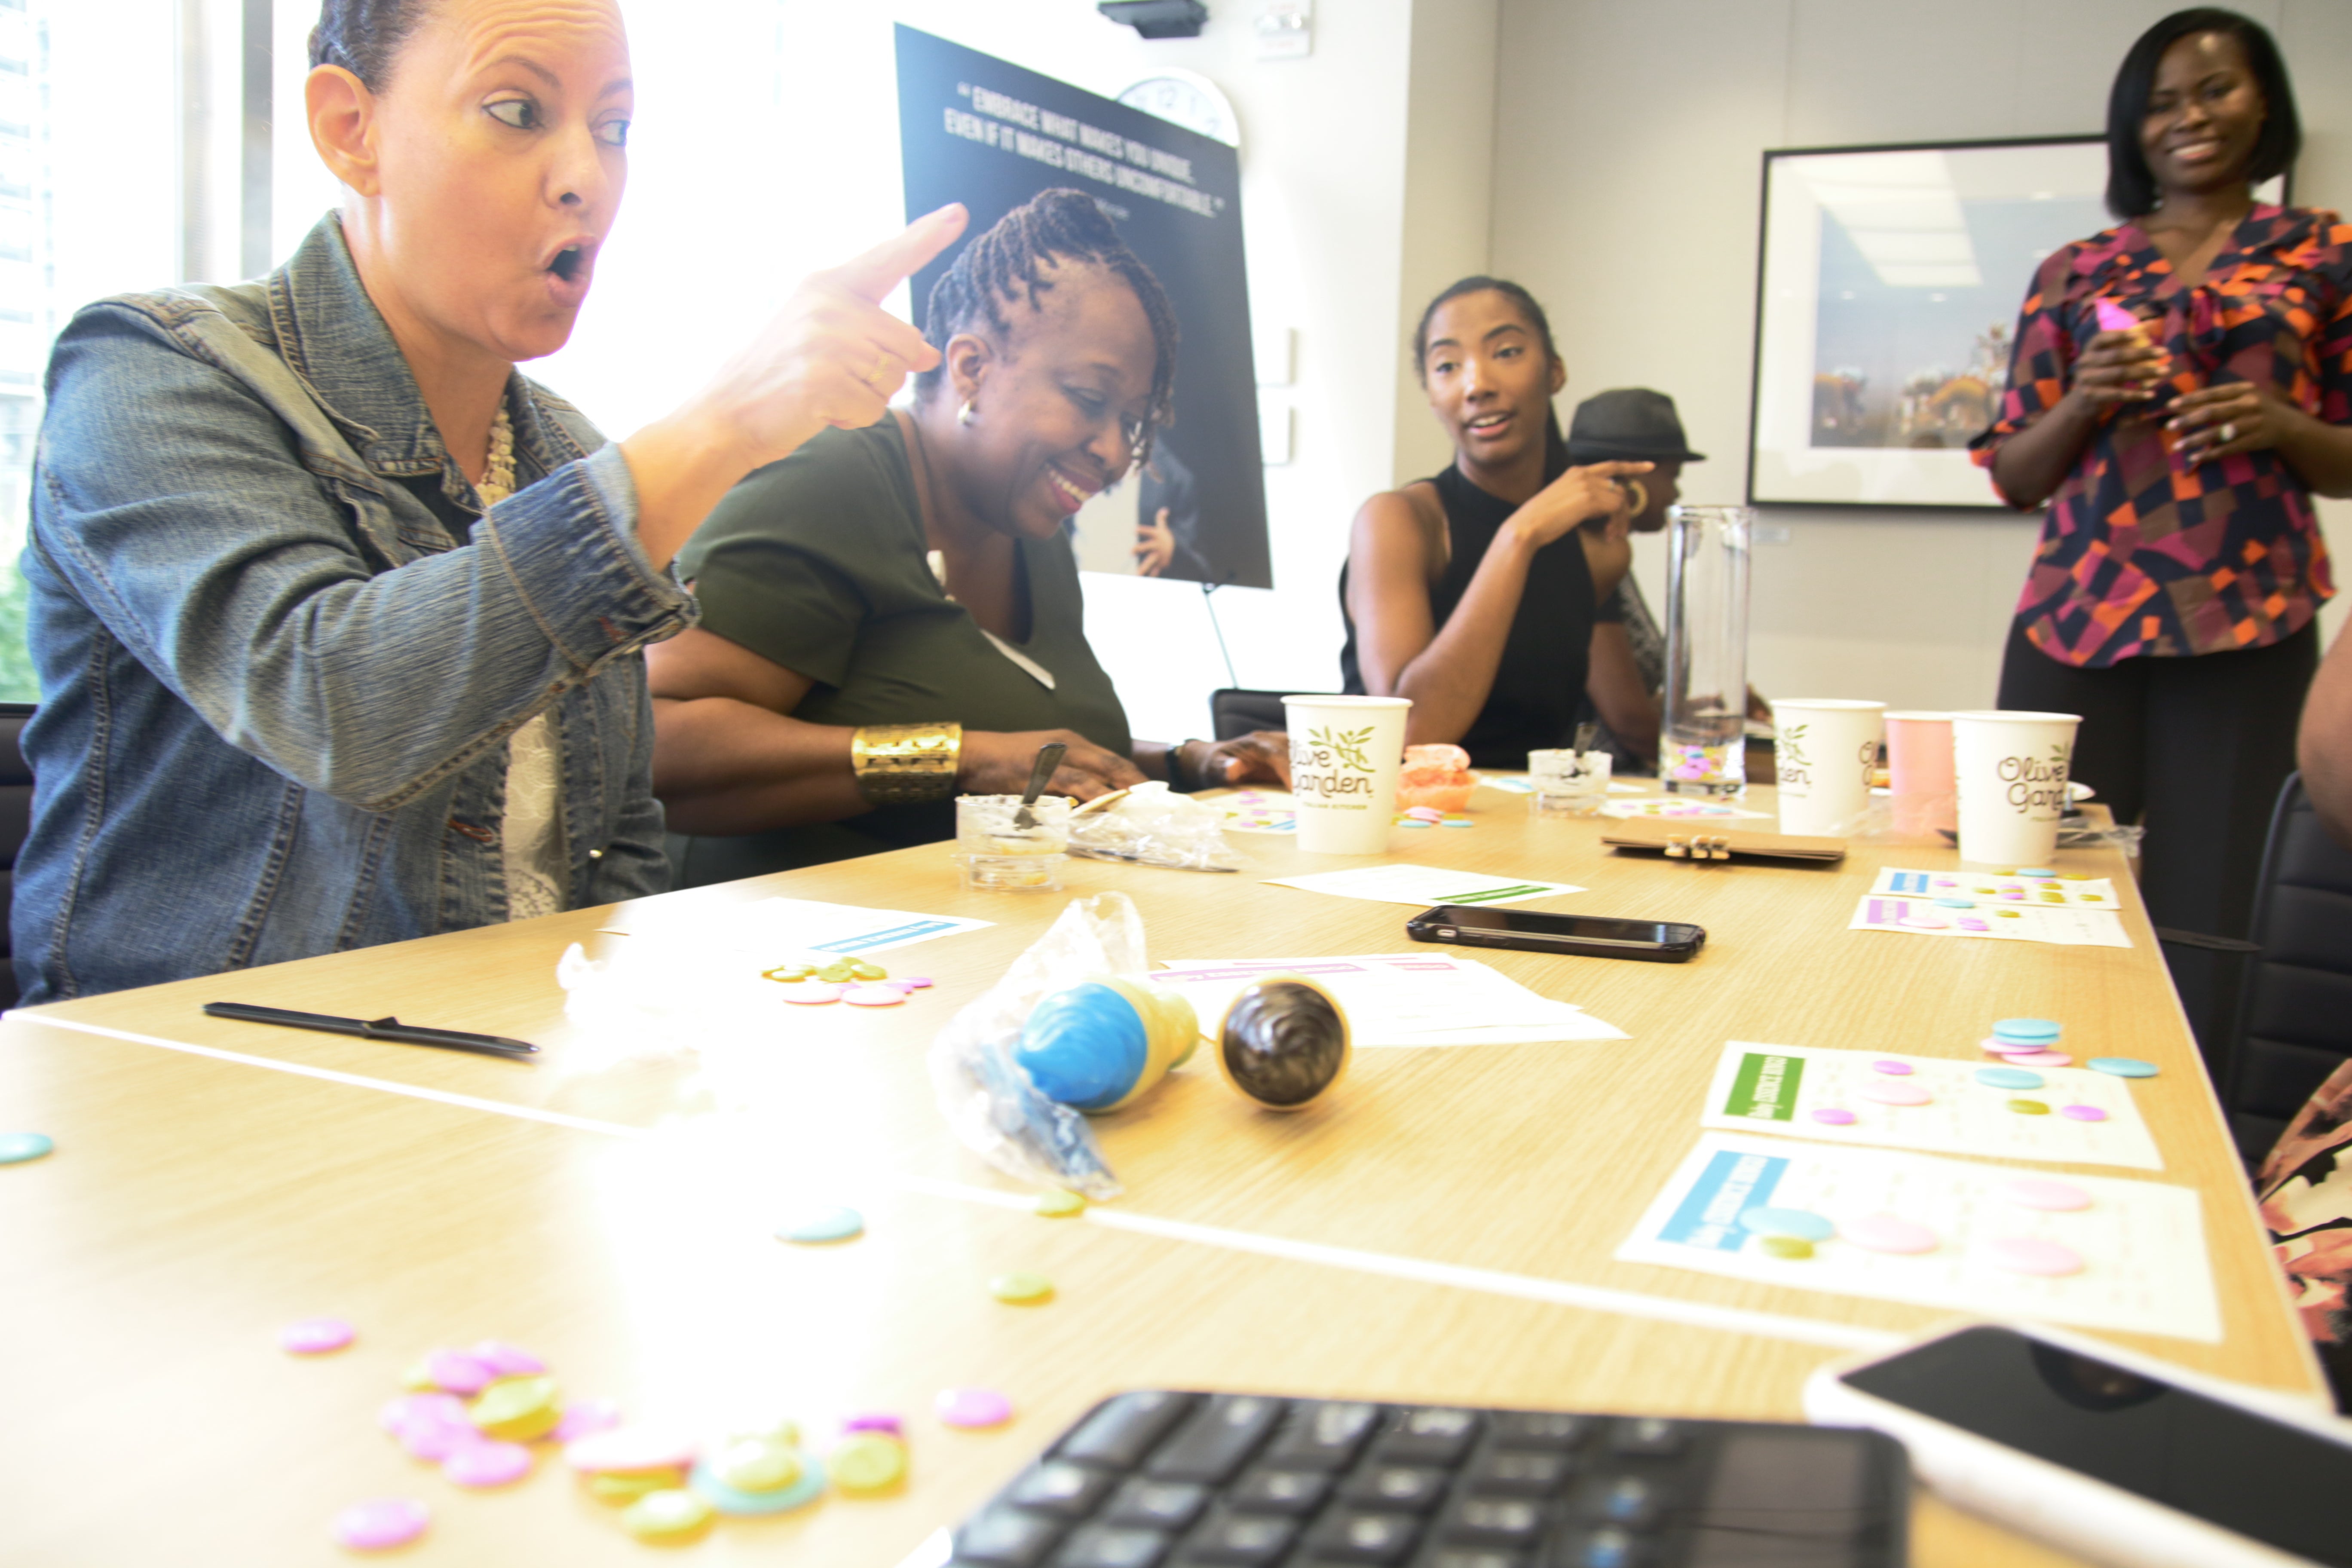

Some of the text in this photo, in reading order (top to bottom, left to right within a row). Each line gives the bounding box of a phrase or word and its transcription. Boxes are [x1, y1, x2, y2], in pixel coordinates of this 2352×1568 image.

[944, 107, 984, 143] EVEN
[985, 120, 999, 147] IF
[1000, 125, 1014, 152] IT
[1015, 130, 1063, 168] MAKES
[1040, 107, 1078, 144] WHAT
[1079, 122, 1124, 160] MAKES
[1290, 739, 1332, 768] live
[1292, 768, 1375, 798] arden
[1997, 756, 2064, 782] Olive
